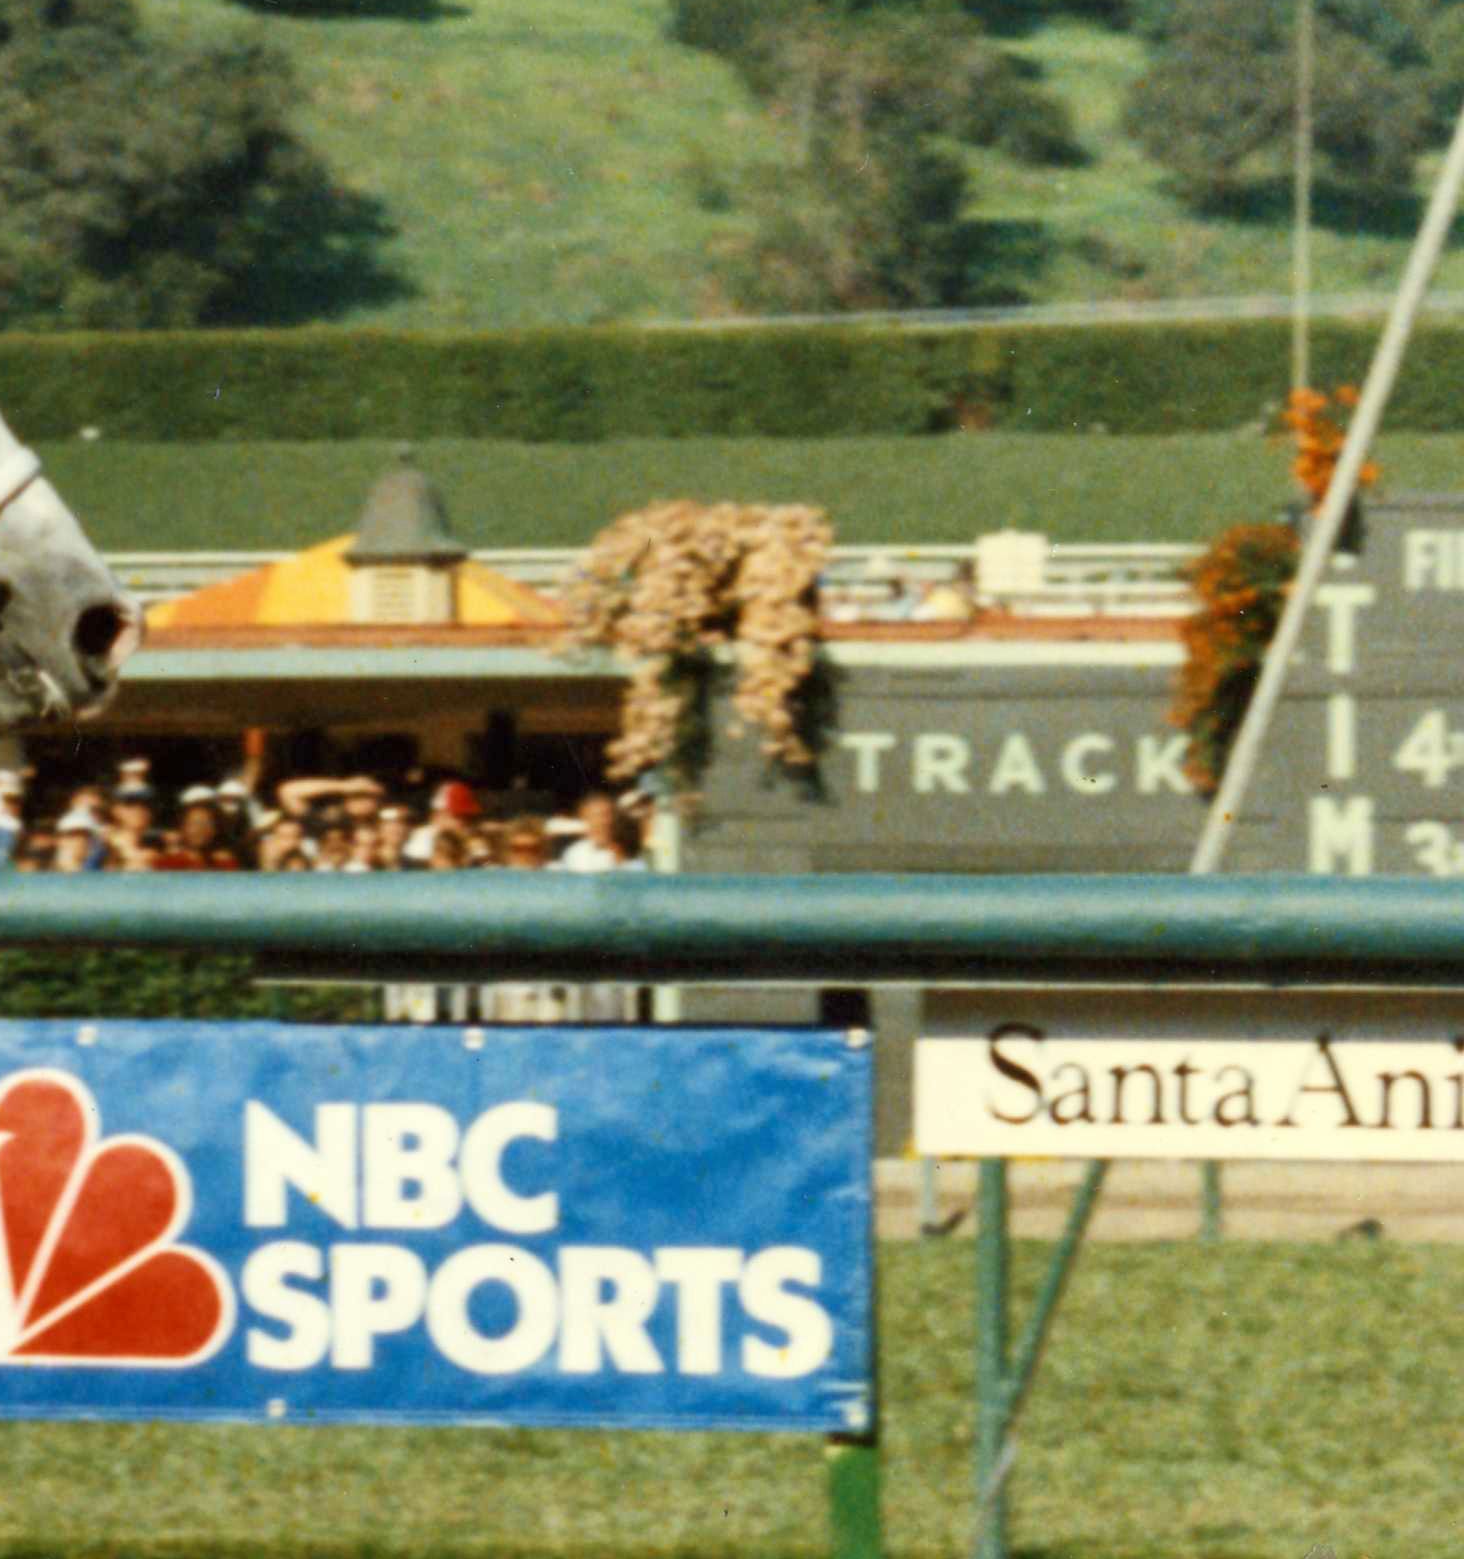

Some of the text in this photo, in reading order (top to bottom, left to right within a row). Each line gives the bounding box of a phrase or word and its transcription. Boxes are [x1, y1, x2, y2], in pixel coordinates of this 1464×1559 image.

[838, 732, 1194, 794] TRACK
[987, 1023, 1259, 1128] Santa
[242, 1098, 559, 1235] NBC
[240, 1239, 835, 1378] SPORTS
